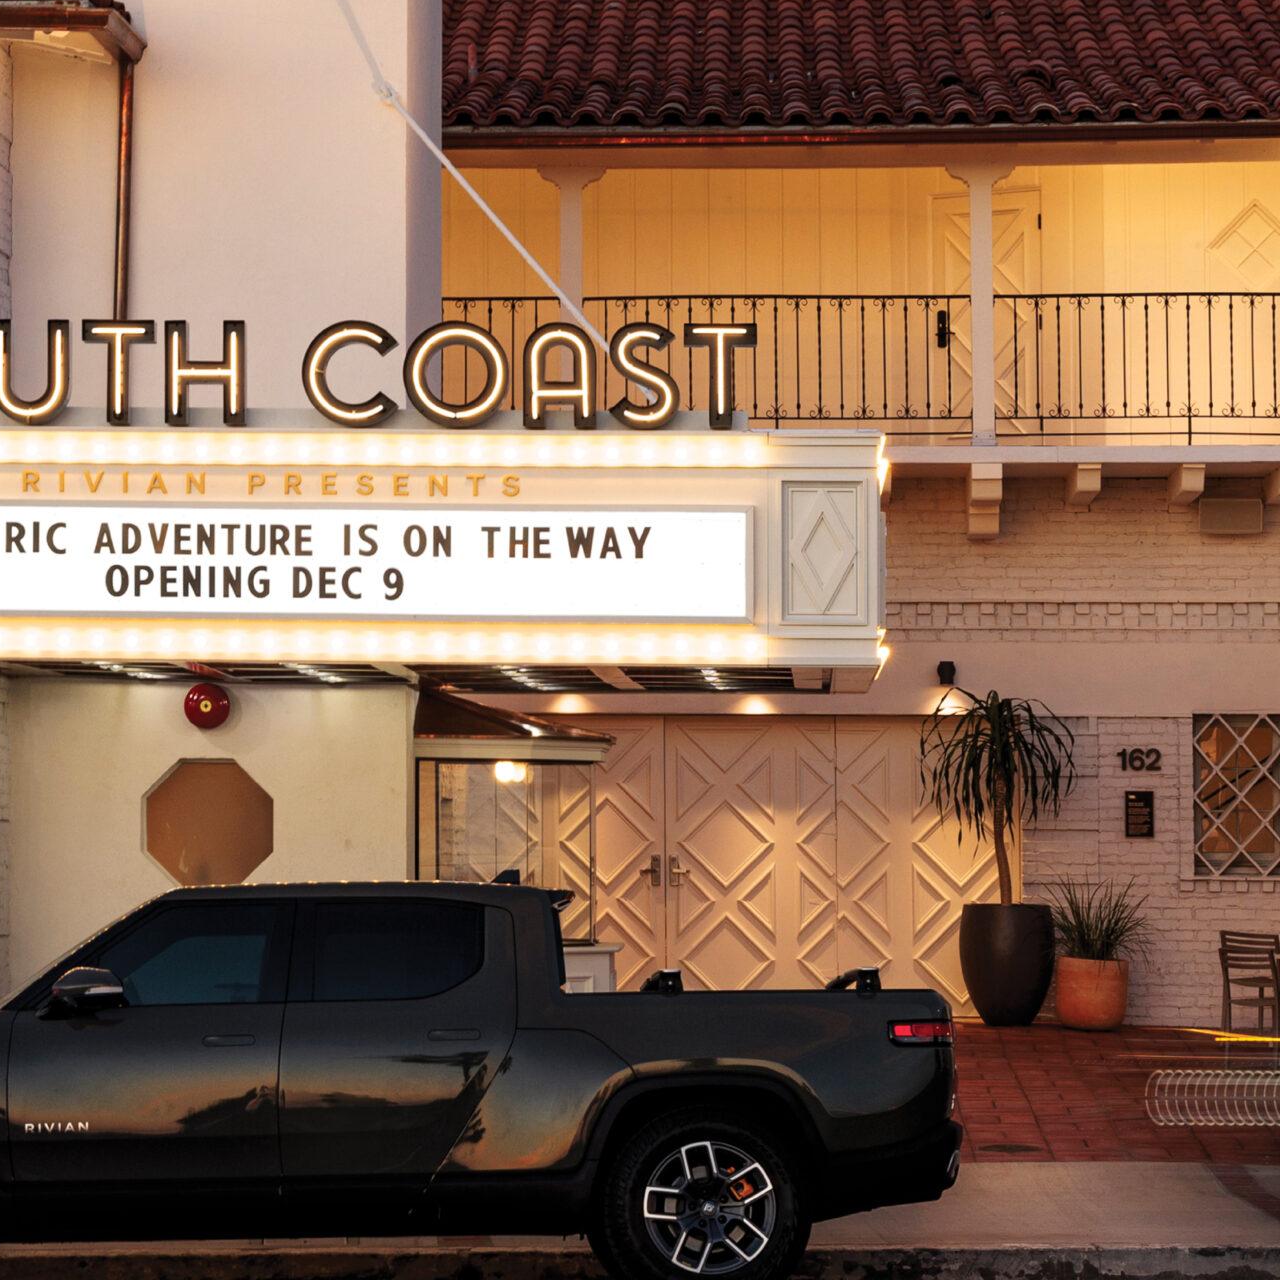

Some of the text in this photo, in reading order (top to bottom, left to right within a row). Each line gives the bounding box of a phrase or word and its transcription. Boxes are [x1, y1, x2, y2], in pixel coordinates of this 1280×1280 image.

[302, 320, 758, 429] COAST
[21, 470, 521, 497] RIVIAN PRESENTS
[93, 523, 314, 557] ADVENTURE
[343, 523, 378, 557] IS
[403, 524, 452, 558] ON
[481, 526, 552, 559] THE
[565, 526, 652, 560] WAY
[105, 564, 405, 602] OPENING DEC 9
[1116, 748, 1162, 771] 162
[24, 1122, 89, 1133] RIVIAN
